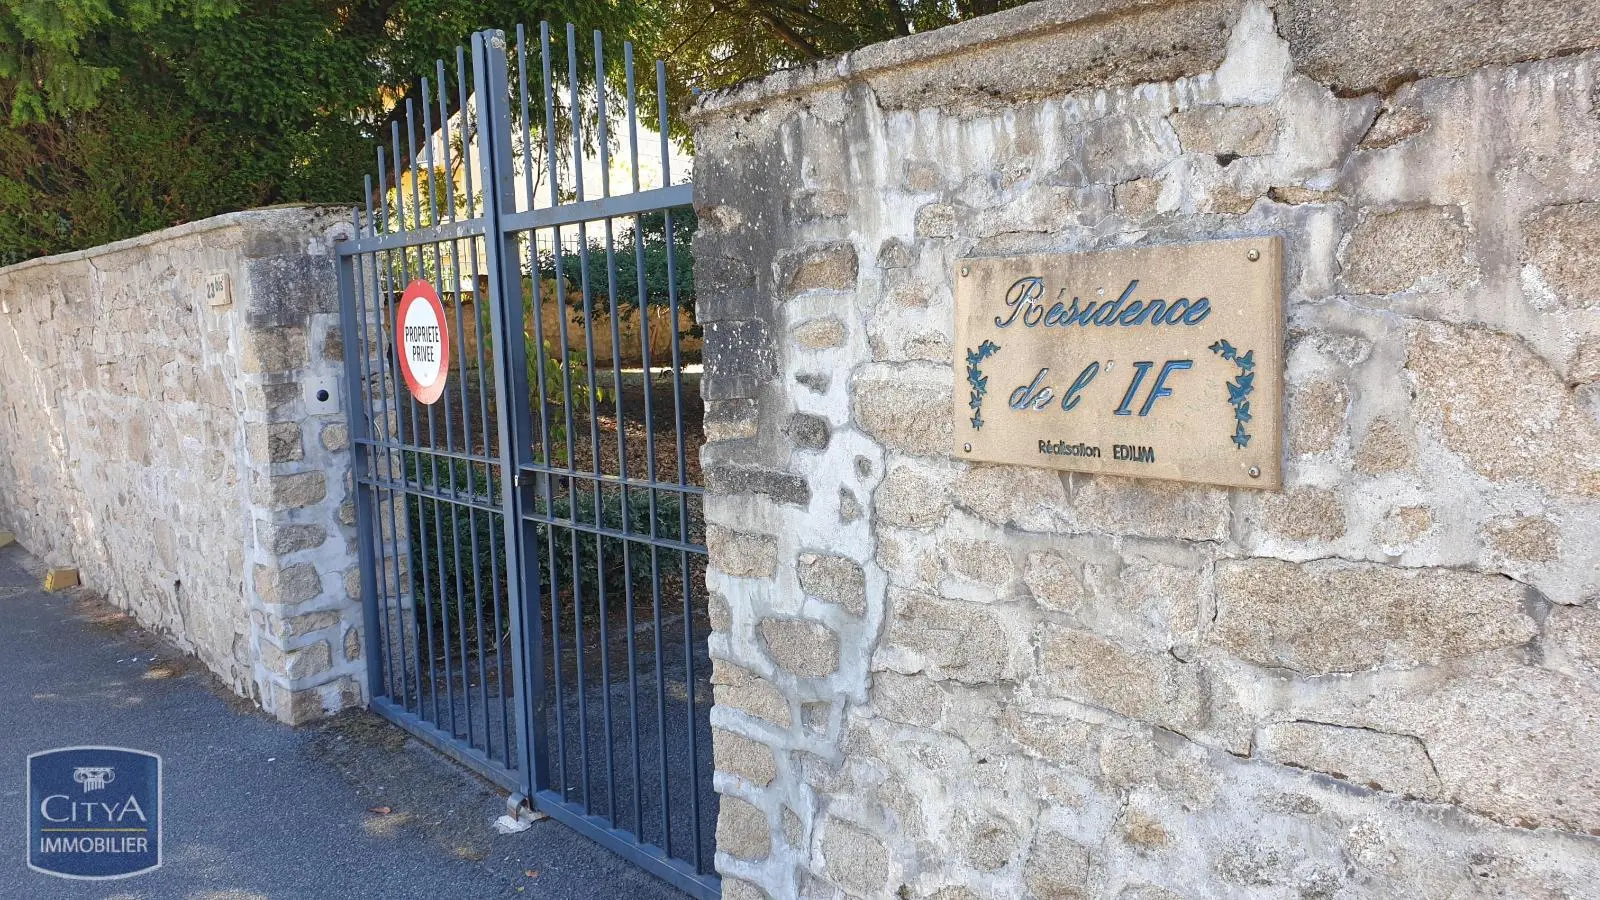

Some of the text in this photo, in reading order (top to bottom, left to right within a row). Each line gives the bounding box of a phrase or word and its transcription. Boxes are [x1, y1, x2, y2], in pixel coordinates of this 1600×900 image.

[994, 275, 1212, 329] Résidence
[1008, 366, 1055, 412] de
[1038, 439, 1101, 458] Réalisation
